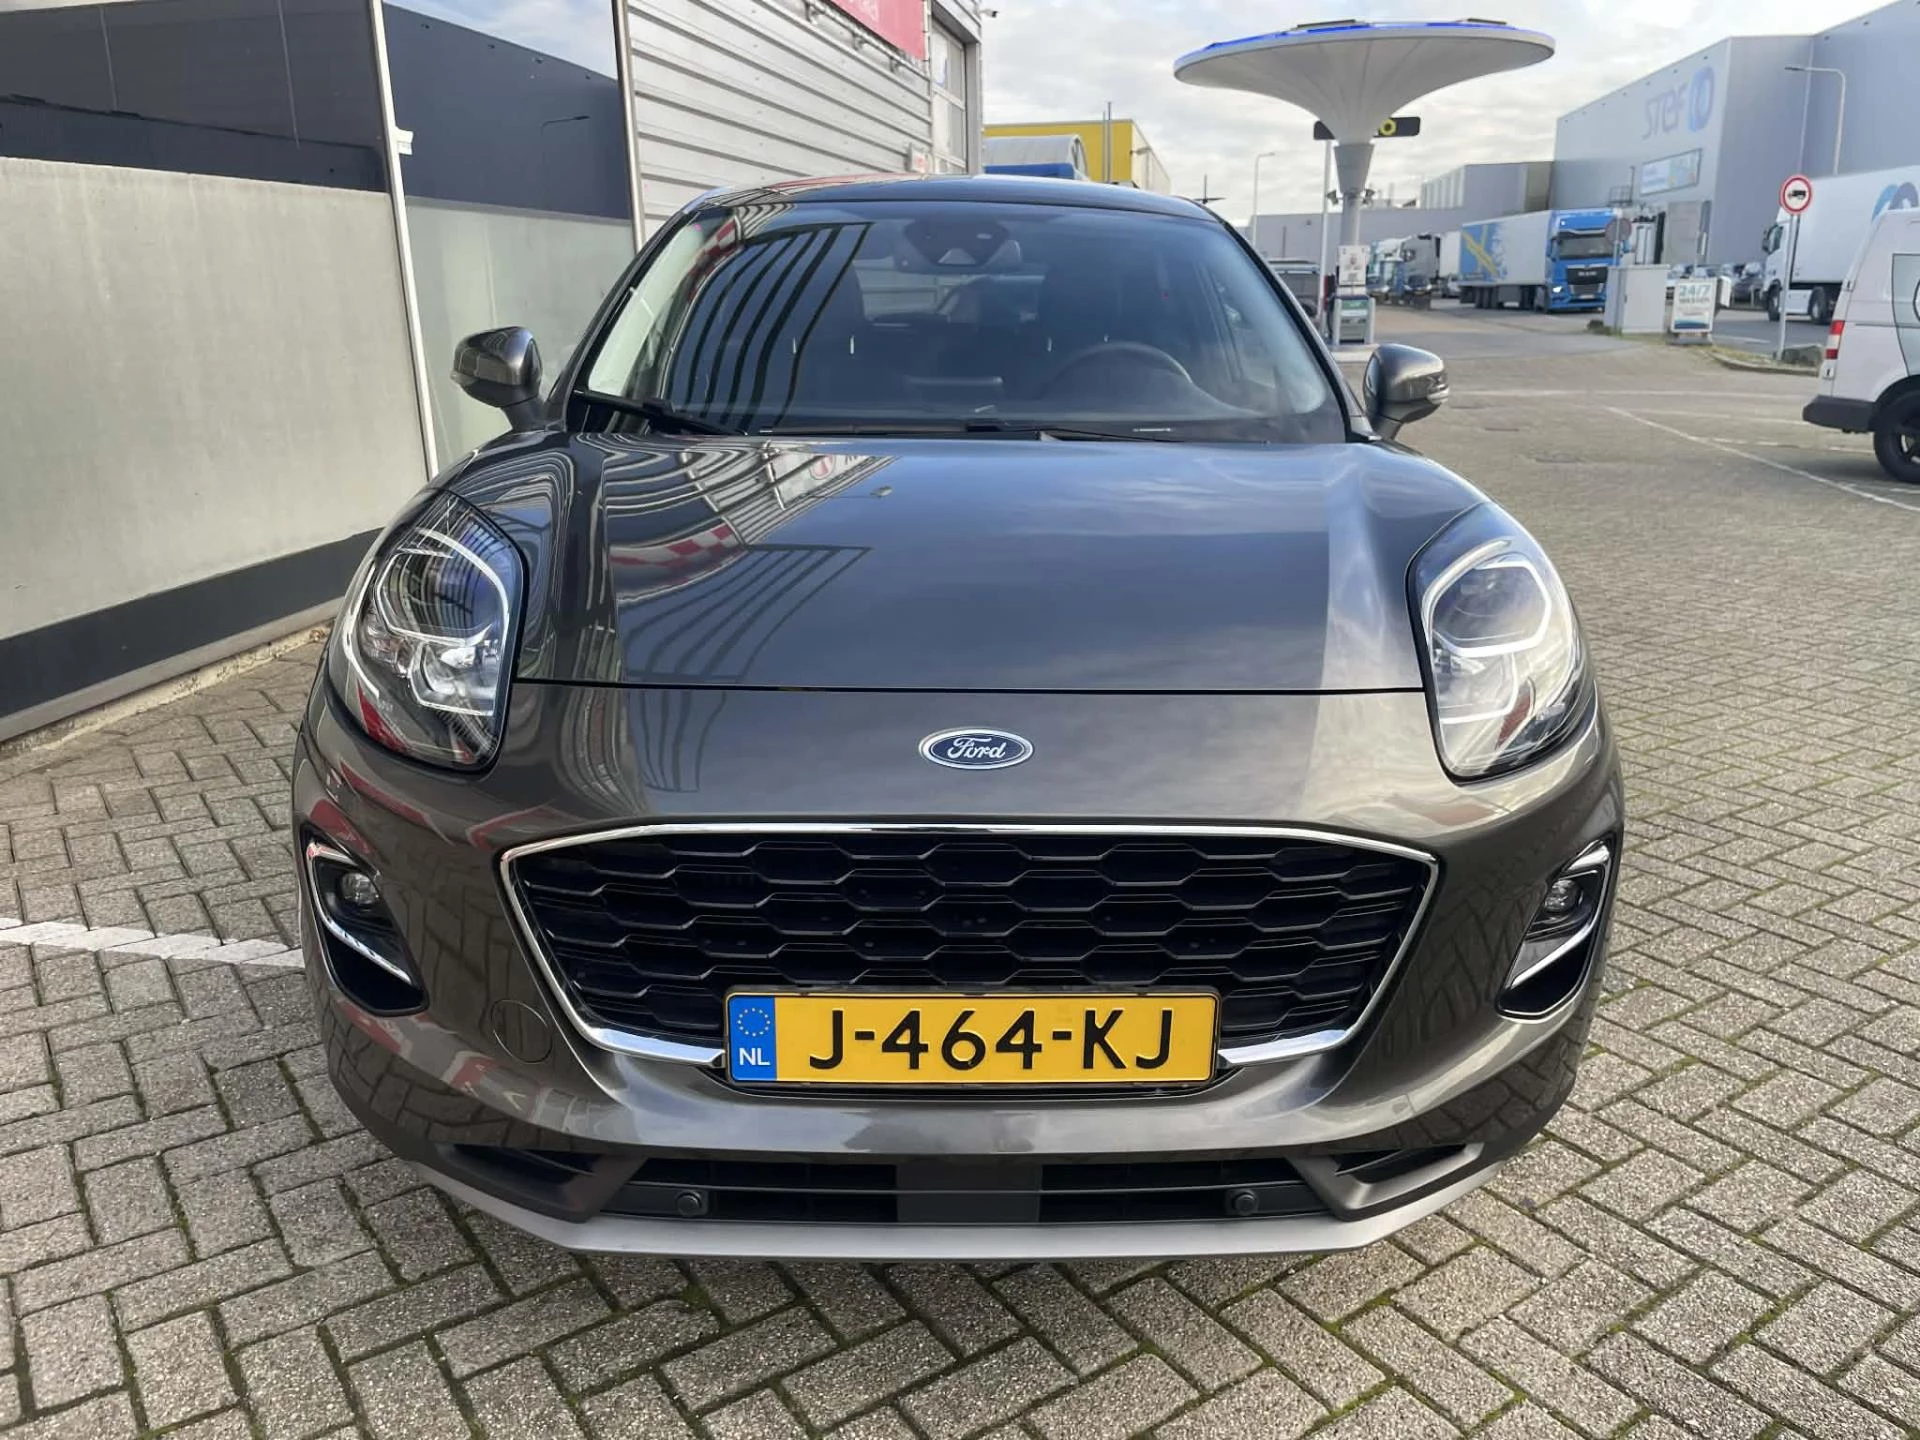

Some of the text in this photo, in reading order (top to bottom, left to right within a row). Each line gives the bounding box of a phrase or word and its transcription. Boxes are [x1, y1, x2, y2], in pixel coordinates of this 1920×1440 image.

[947, 737, 1007, 759] Ford
[809, 1008, 1173, 1070] J-464-KJ
[739, 1047, 770, 1067] NL
